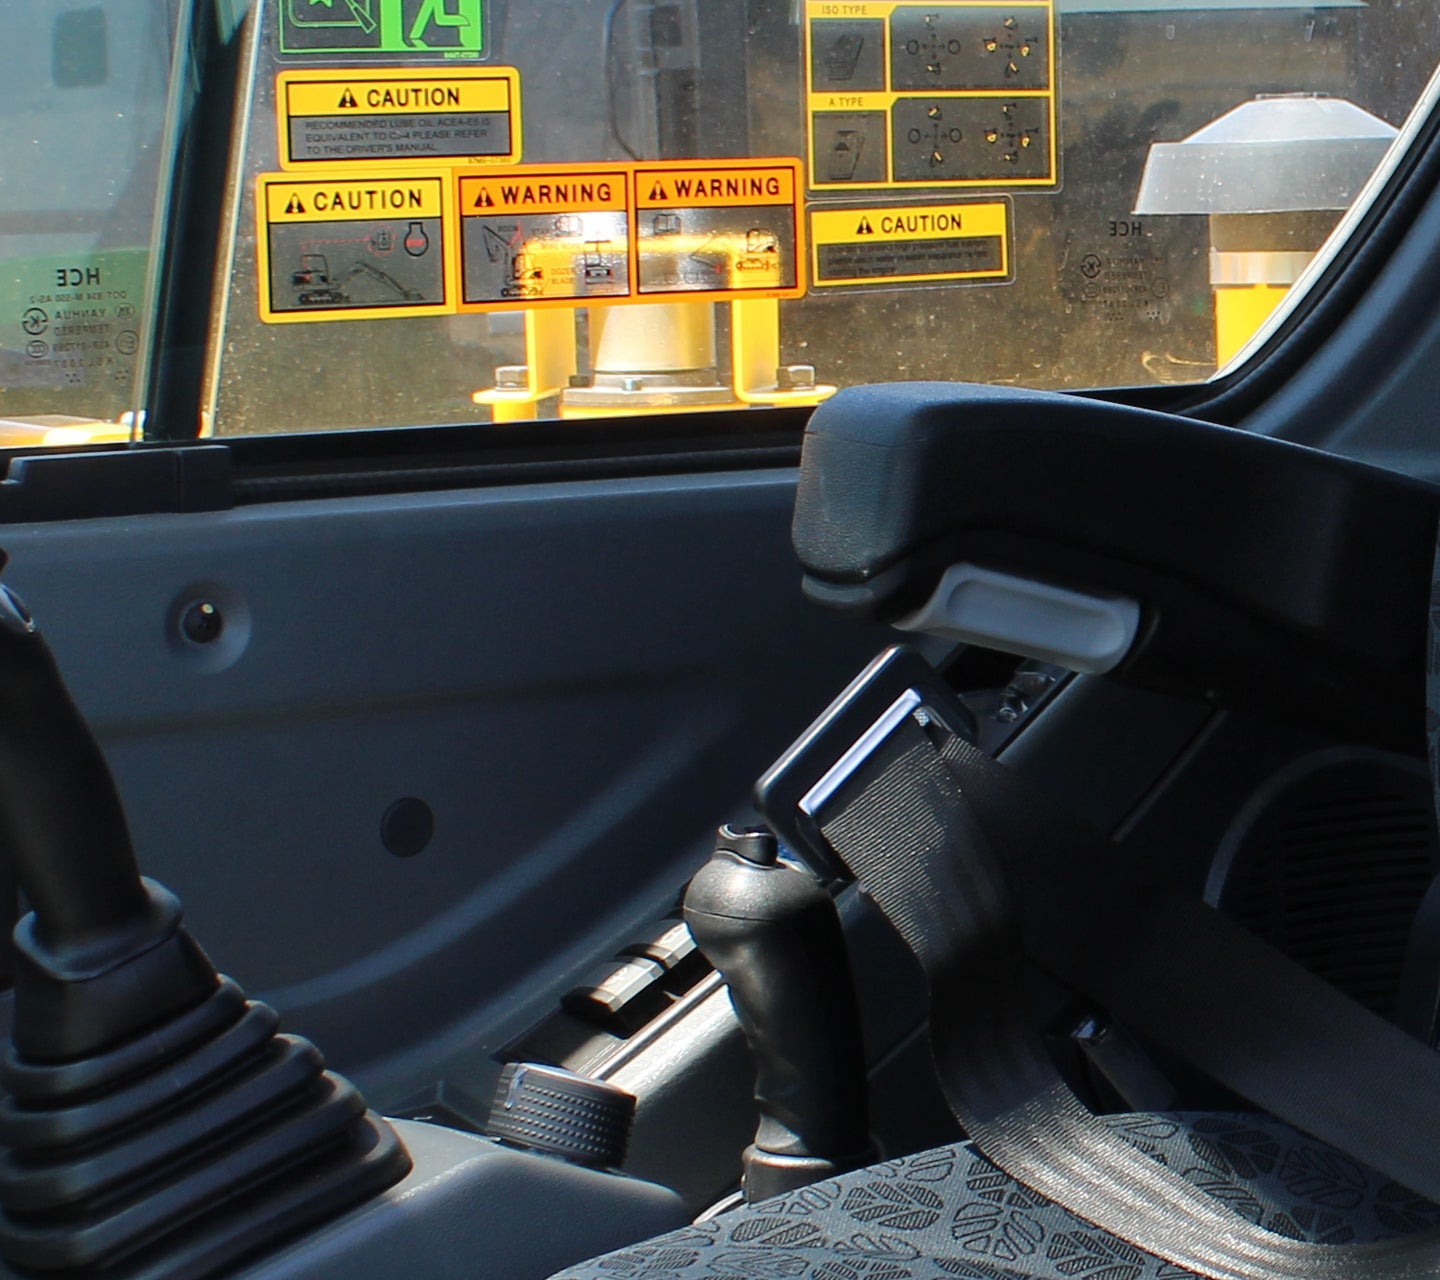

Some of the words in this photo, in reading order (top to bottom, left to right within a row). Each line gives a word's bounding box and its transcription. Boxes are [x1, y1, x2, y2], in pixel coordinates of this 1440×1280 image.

[821, 4, 839, 16] ISO
[843, 4, 868, 16] TYPE
[366, 87, 461, 108] CAUTION
[840, 96, 864, 107] TYPE
[500, 182, 612, 205] WARNING
[674, 176, 780, 198] WARNING
[313, 189, 423, 211] CAUTION
[881, 213, 963, 233] CAUTION
